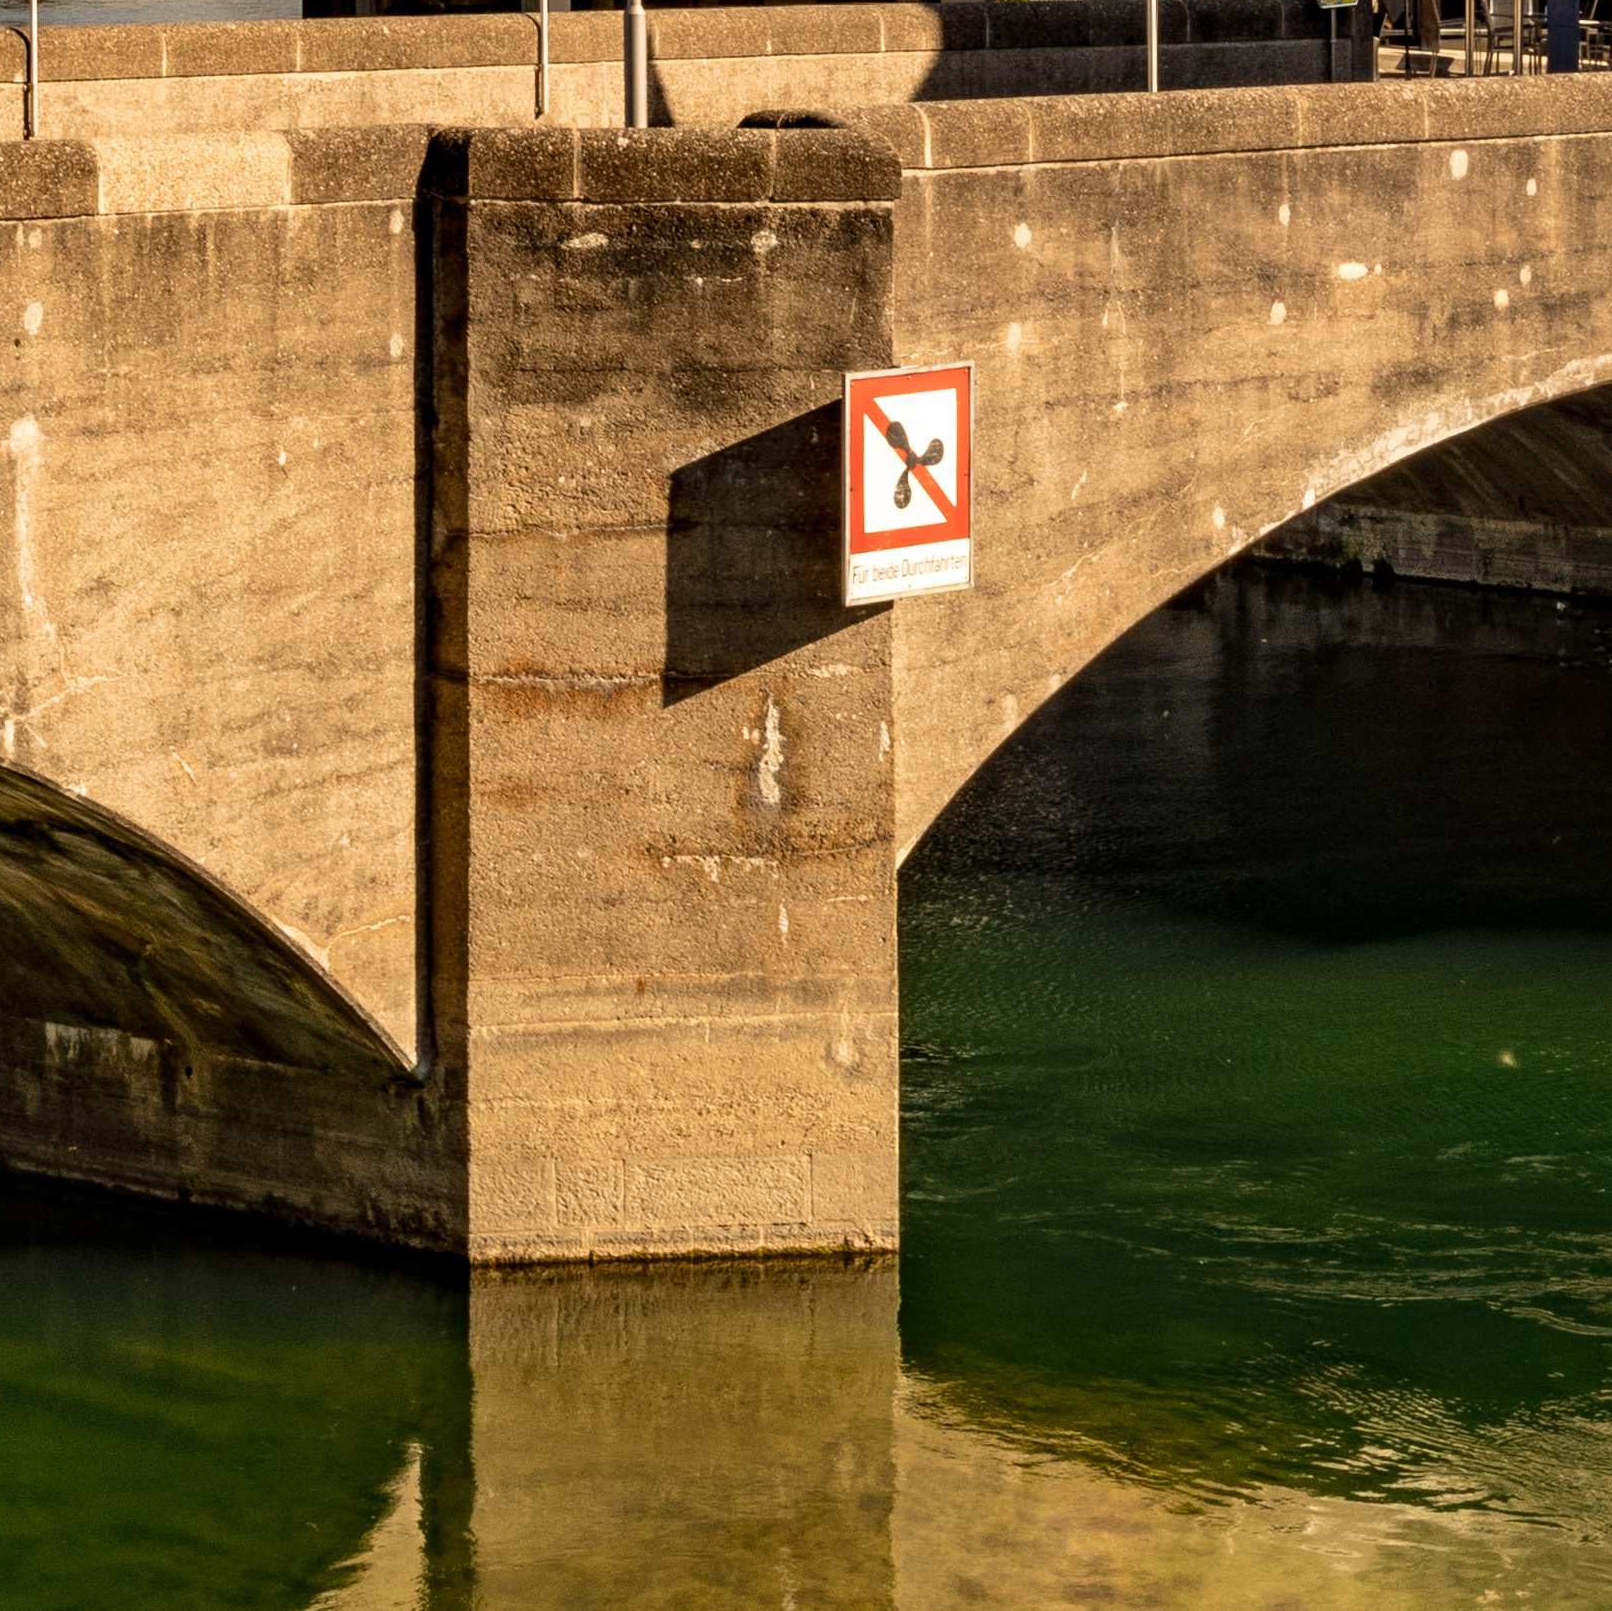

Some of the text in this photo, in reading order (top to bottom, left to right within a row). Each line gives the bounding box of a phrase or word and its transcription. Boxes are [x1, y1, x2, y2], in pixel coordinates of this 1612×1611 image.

[852, 554, 967, 584] Für beide Durchfahrten
